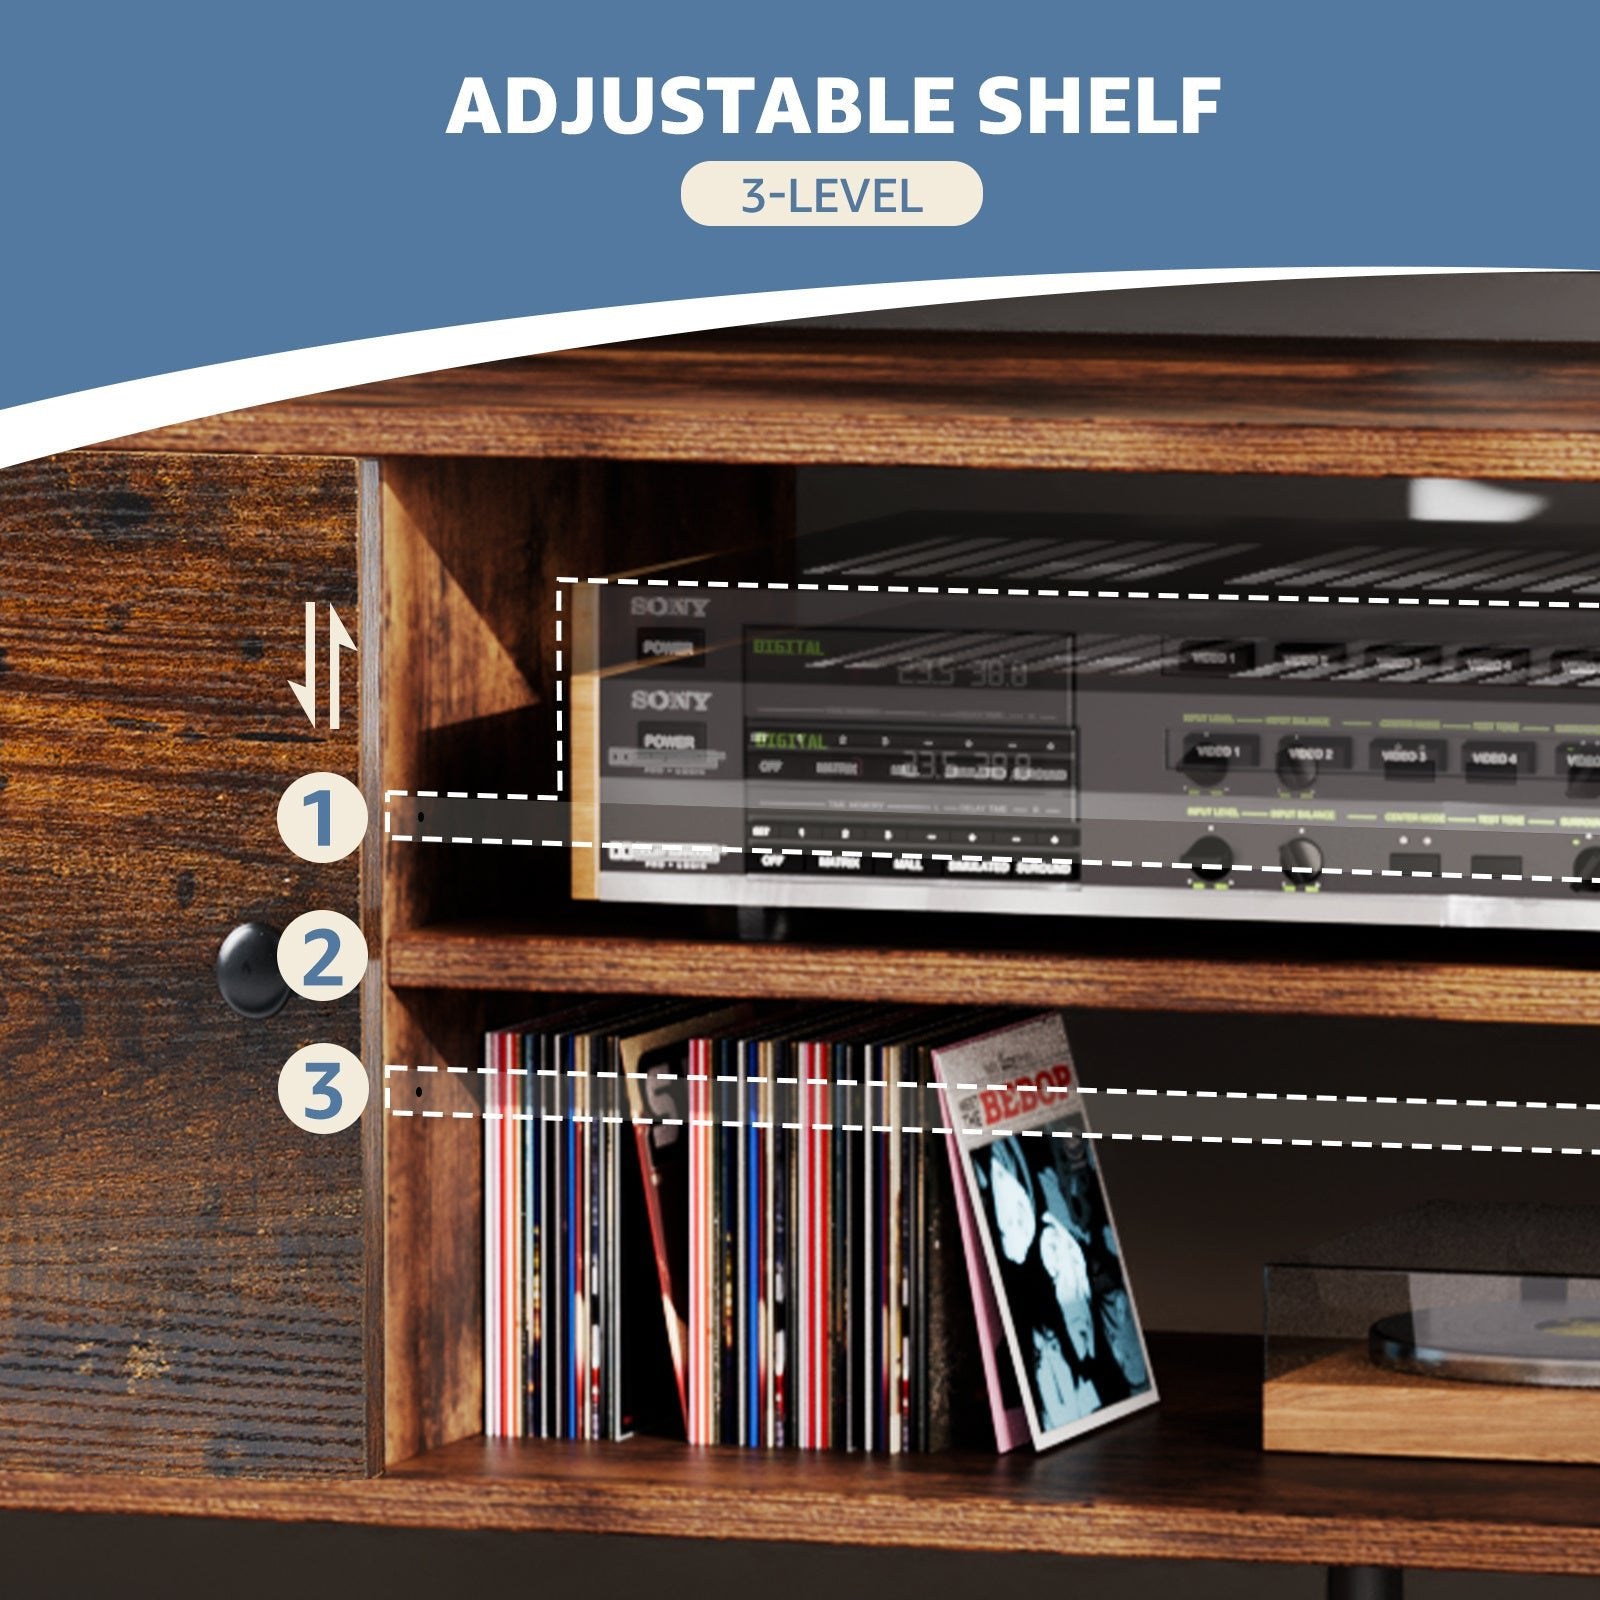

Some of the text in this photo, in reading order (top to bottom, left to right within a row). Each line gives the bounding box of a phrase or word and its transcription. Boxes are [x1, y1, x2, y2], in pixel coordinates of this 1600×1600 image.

[631, 597, 710, 618] SONY
[753, 639, 824, 656] DIGITAL
[631, 690, 712, 711] SONY
[644, 734, 695, 750] POWER
[754, 732, 827, 749] DIGITAL
[1197, 746, 1232, 757] VIDEO
[1289, 748, 1323, 760] VIDEO
[1382, 751, 1417, 763] VIDEO
[1472, 753, 1506, 764] VIDEO
[760, 854, 786, 867] OFF
[818, 855, 861, 869] MATRIX
[893, 857, 923, 871] HALL
[979, 1063, 1071, 1126] BEBOP
